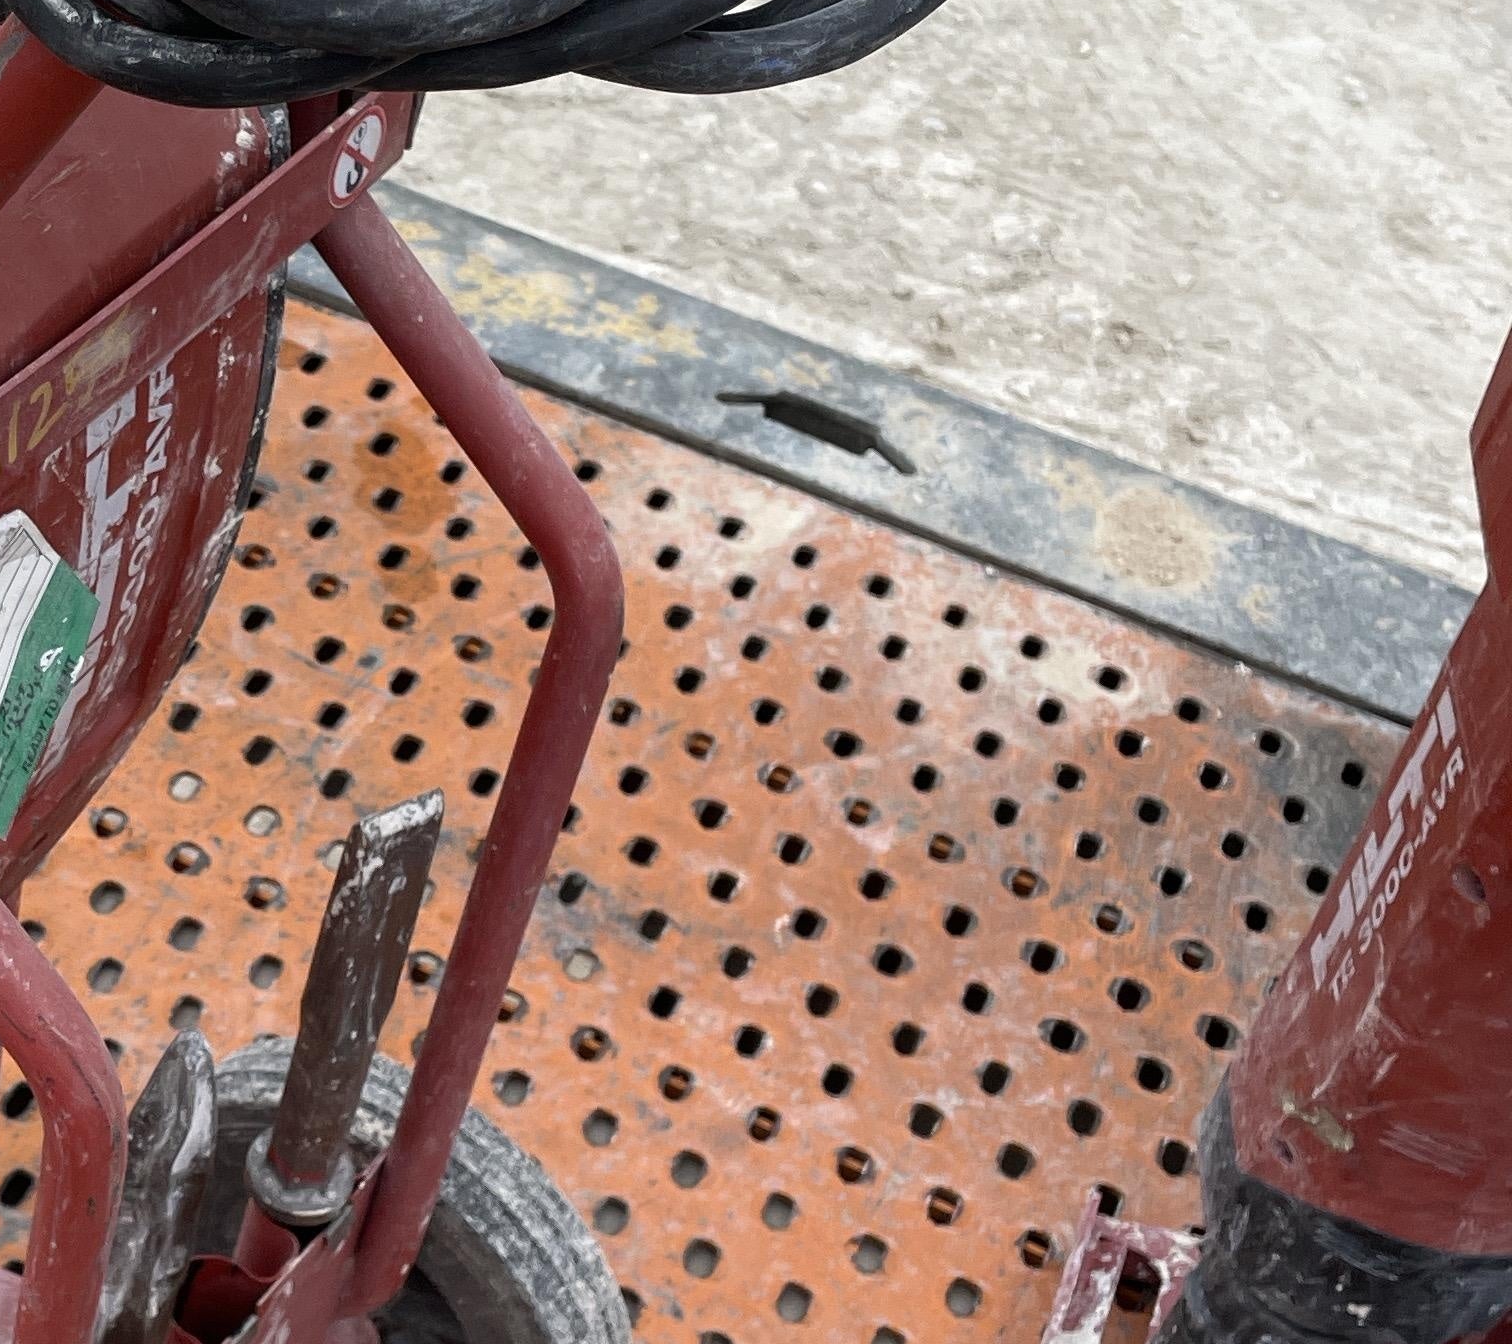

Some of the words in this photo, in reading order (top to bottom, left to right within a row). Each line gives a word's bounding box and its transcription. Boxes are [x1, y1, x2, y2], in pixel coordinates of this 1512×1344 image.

[22, 719, 48, 773] READY
[44, 698, 59, 718] TO
[1310, 686, 1456, 990] HILTI
[1358, 746, 1464, 955] 3000-AVR
